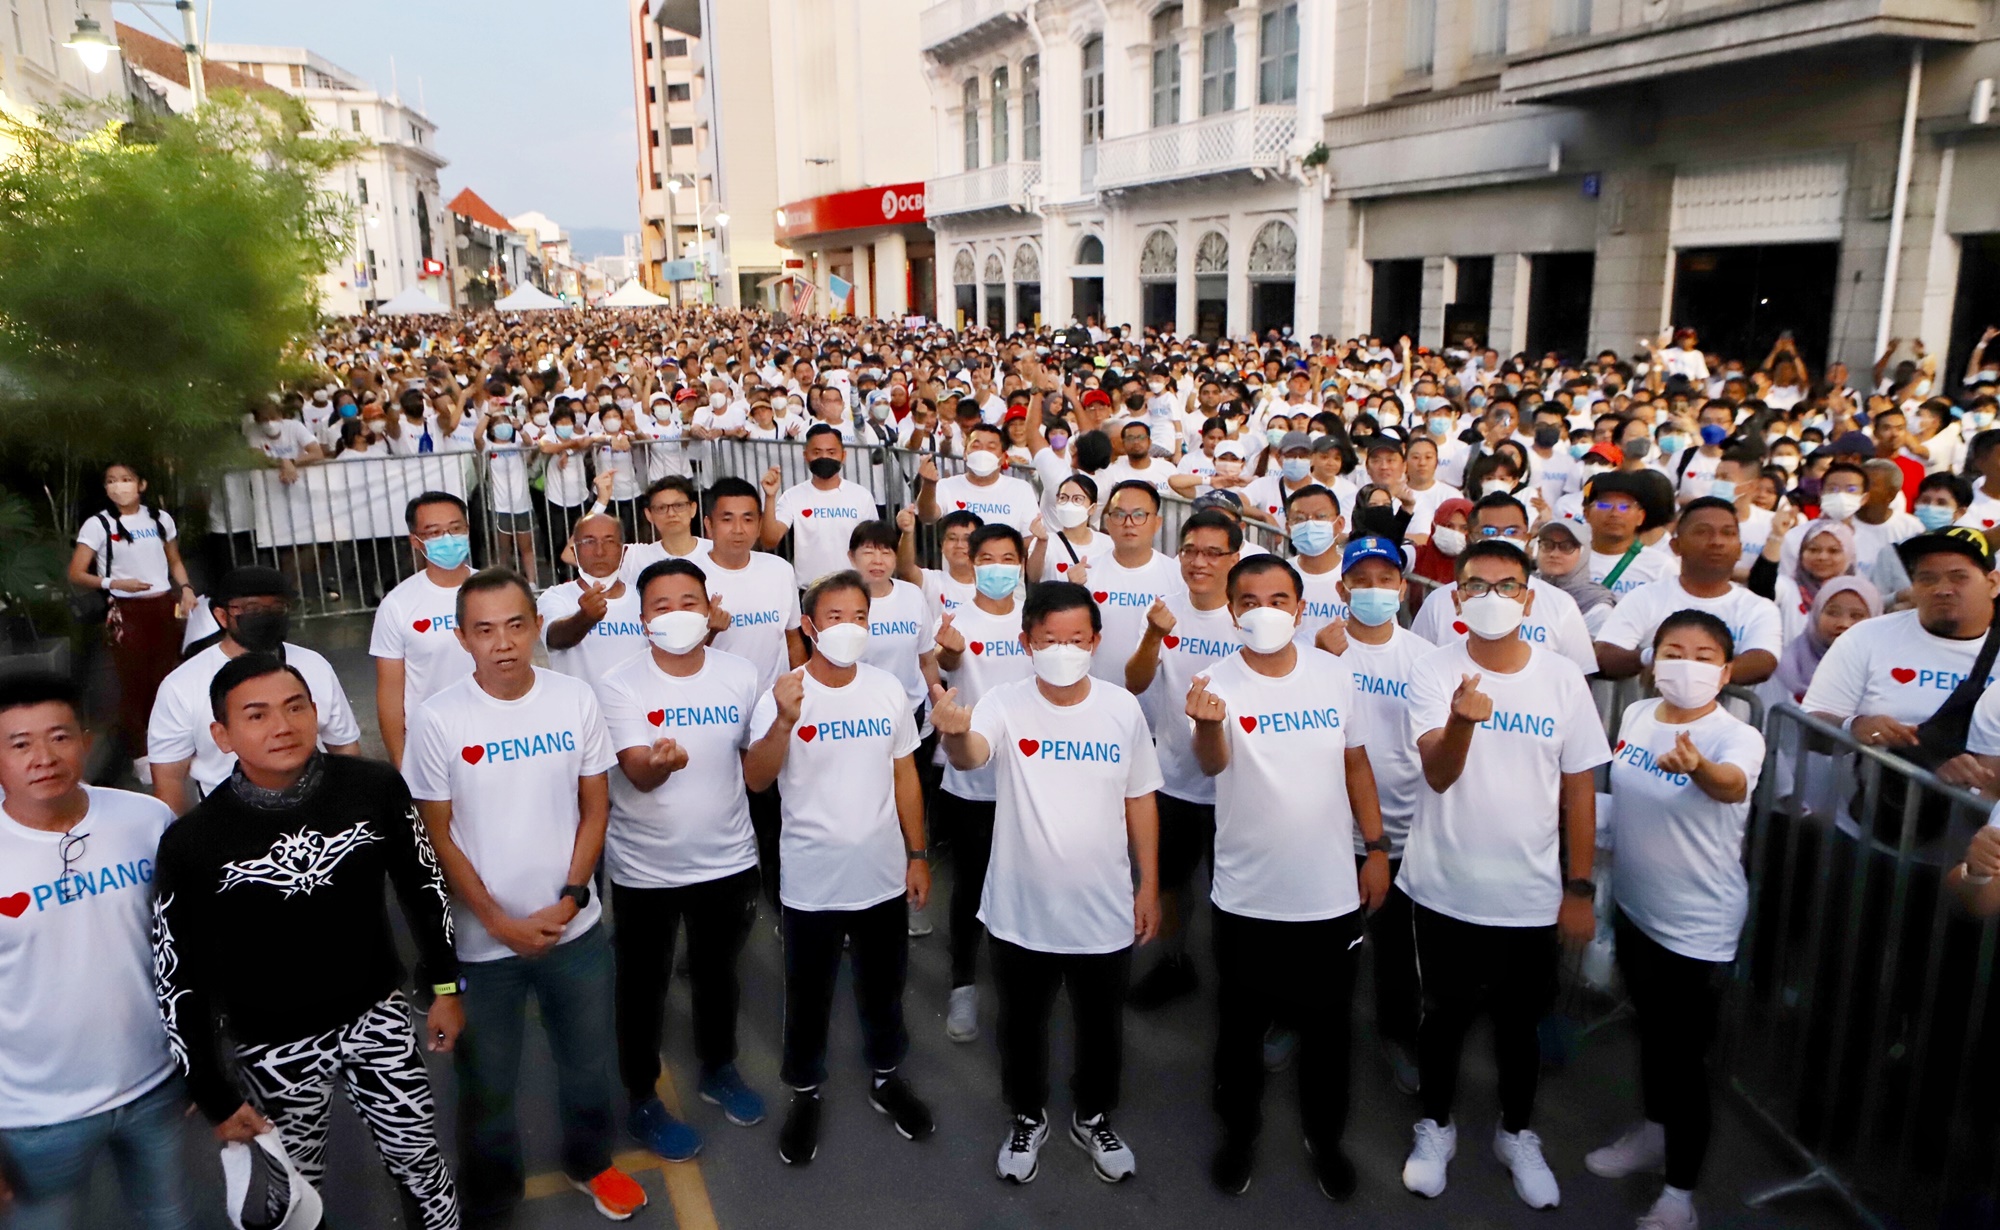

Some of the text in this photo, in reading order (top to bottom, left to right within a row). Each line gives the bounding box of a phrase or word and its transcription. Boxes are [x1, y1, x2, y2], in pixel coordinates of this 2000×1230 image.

[898, 194, 925, 212] OCB
[813, 507, 858, 519] PENANG
[966, 501, 1011, 515] PENANG
[130, 528, 159, 540] ENAN
[1109, 591, 1158, 607] PENAN
[1302, 602, 1349, 620] NANG
[868, 621, 917, 636] ENANG
[985, 641, 1025, 657] PENA
[1353, 672, 1408, 699] ENAN
[1919, 669, 1967, 691] PEN
[665, 705, 739, 727] PENANG
[1258, 708, 1340, 734] PENANG
[1481, 711, 1555, 738] NANG
[818, 718, 892, 741] PENANG
[486, 731, 576, 763] PENANG
[1041, 740, 1120, 763] PENANG
[32, 858, 153, 912] PENANG
